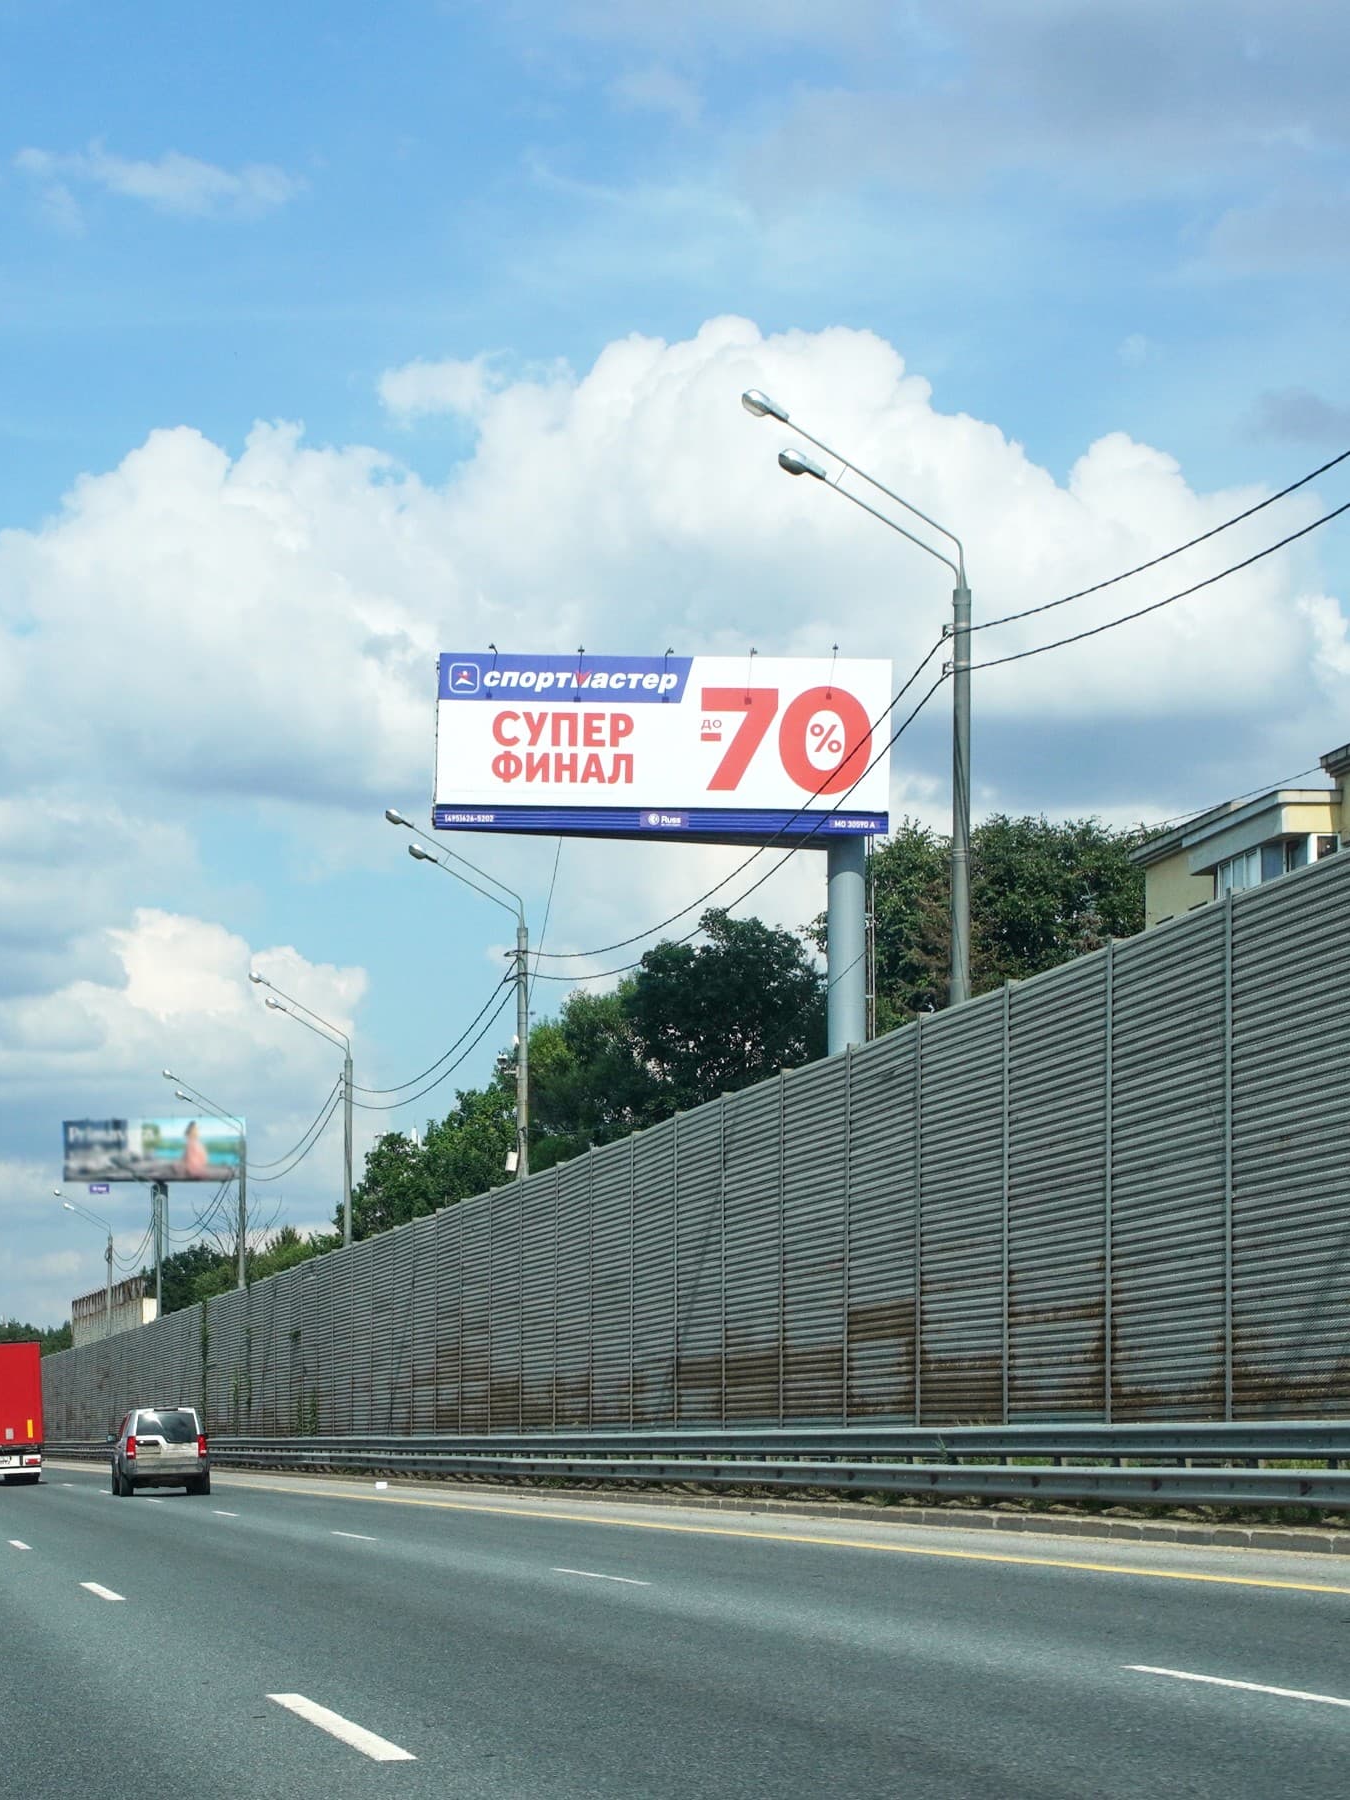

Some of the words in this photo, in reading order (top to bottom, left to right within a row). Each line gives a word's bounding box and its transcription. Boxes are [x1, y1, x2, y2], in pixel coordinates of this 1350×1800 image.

[483, 670, 678, 693] спортмастер
[492, 711, 634, 747] СУПЕР
[491, 751, 634, 784] ФИНАЛ
